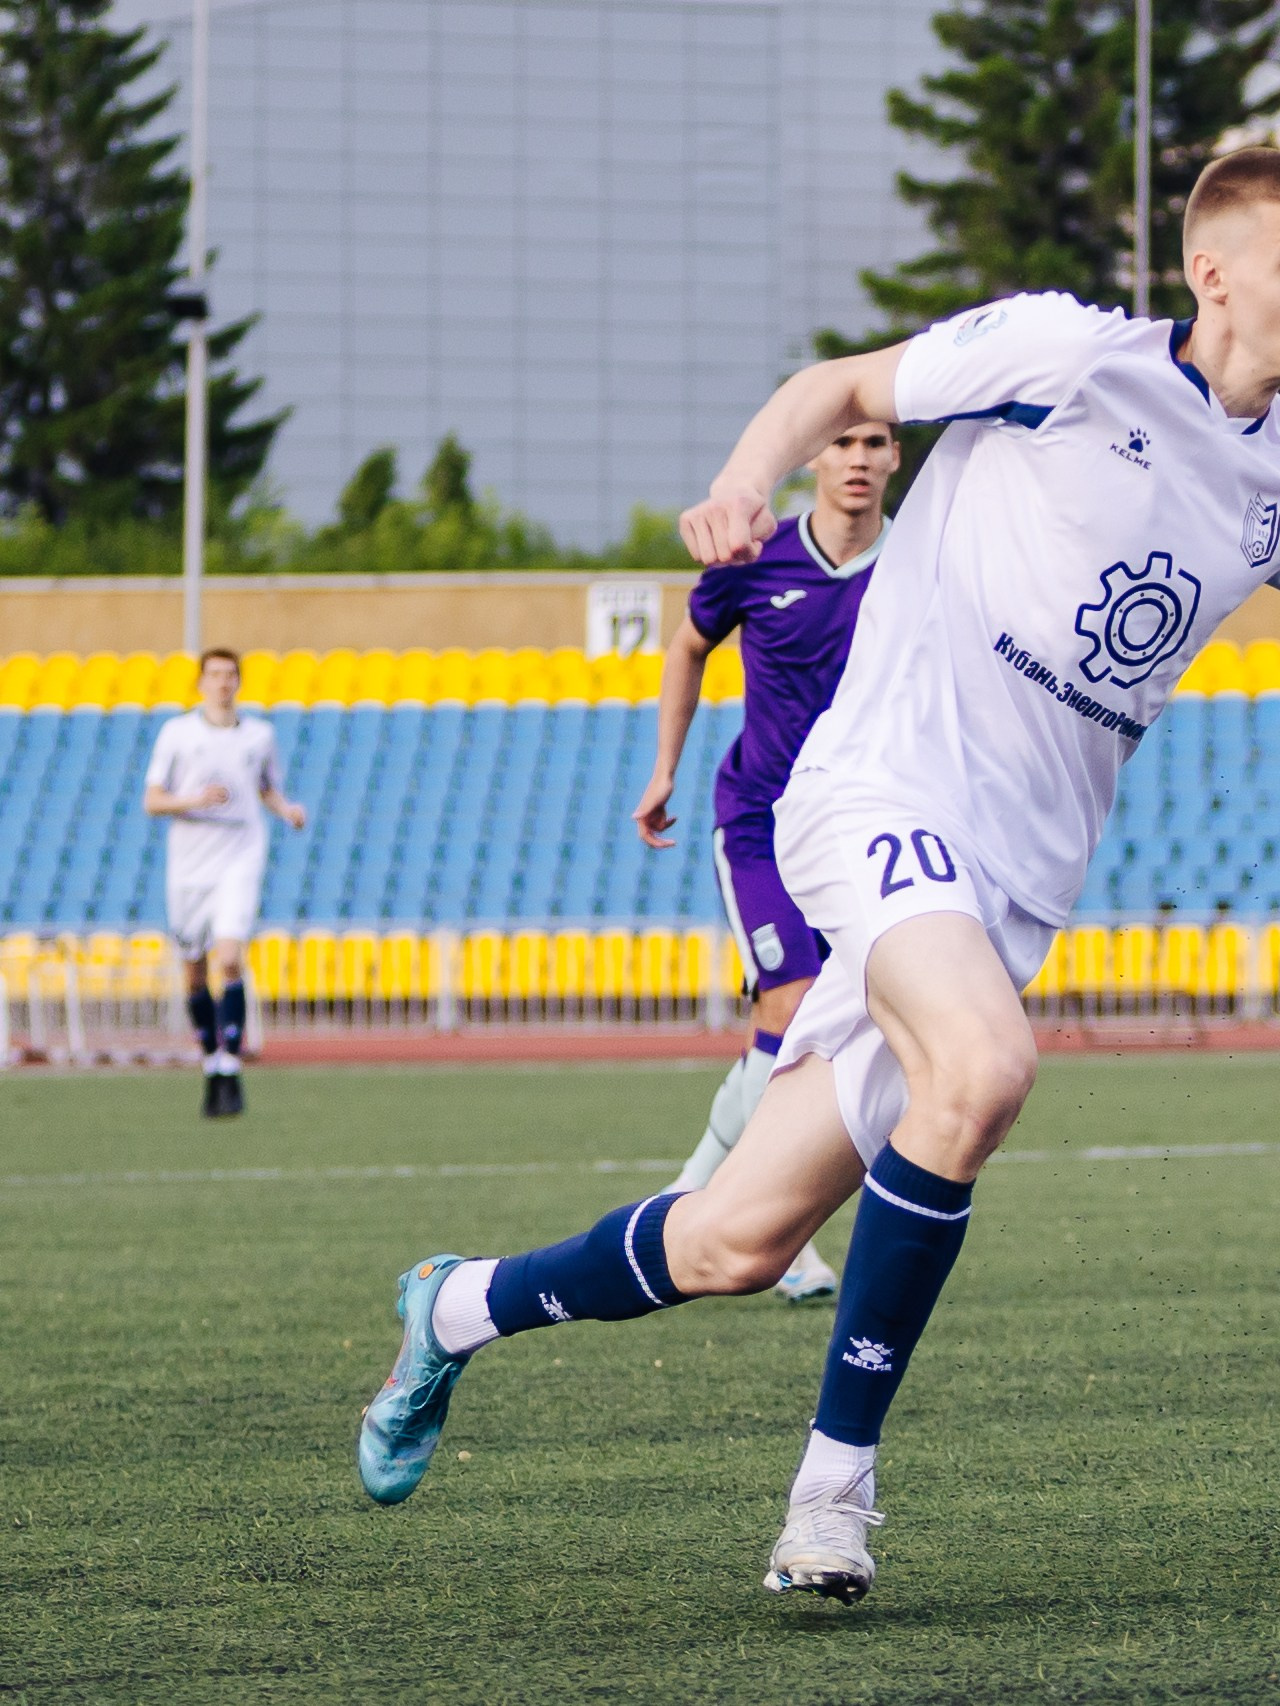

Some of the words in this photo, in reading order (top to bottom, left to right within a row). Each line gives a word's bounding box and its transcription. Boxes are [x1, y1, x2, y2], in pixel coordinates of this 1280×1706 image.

[1110, 443, 1152, 470] KELME
[867, 829, 957, 900] 20
[842, 1352, 892, 1372] KELME
